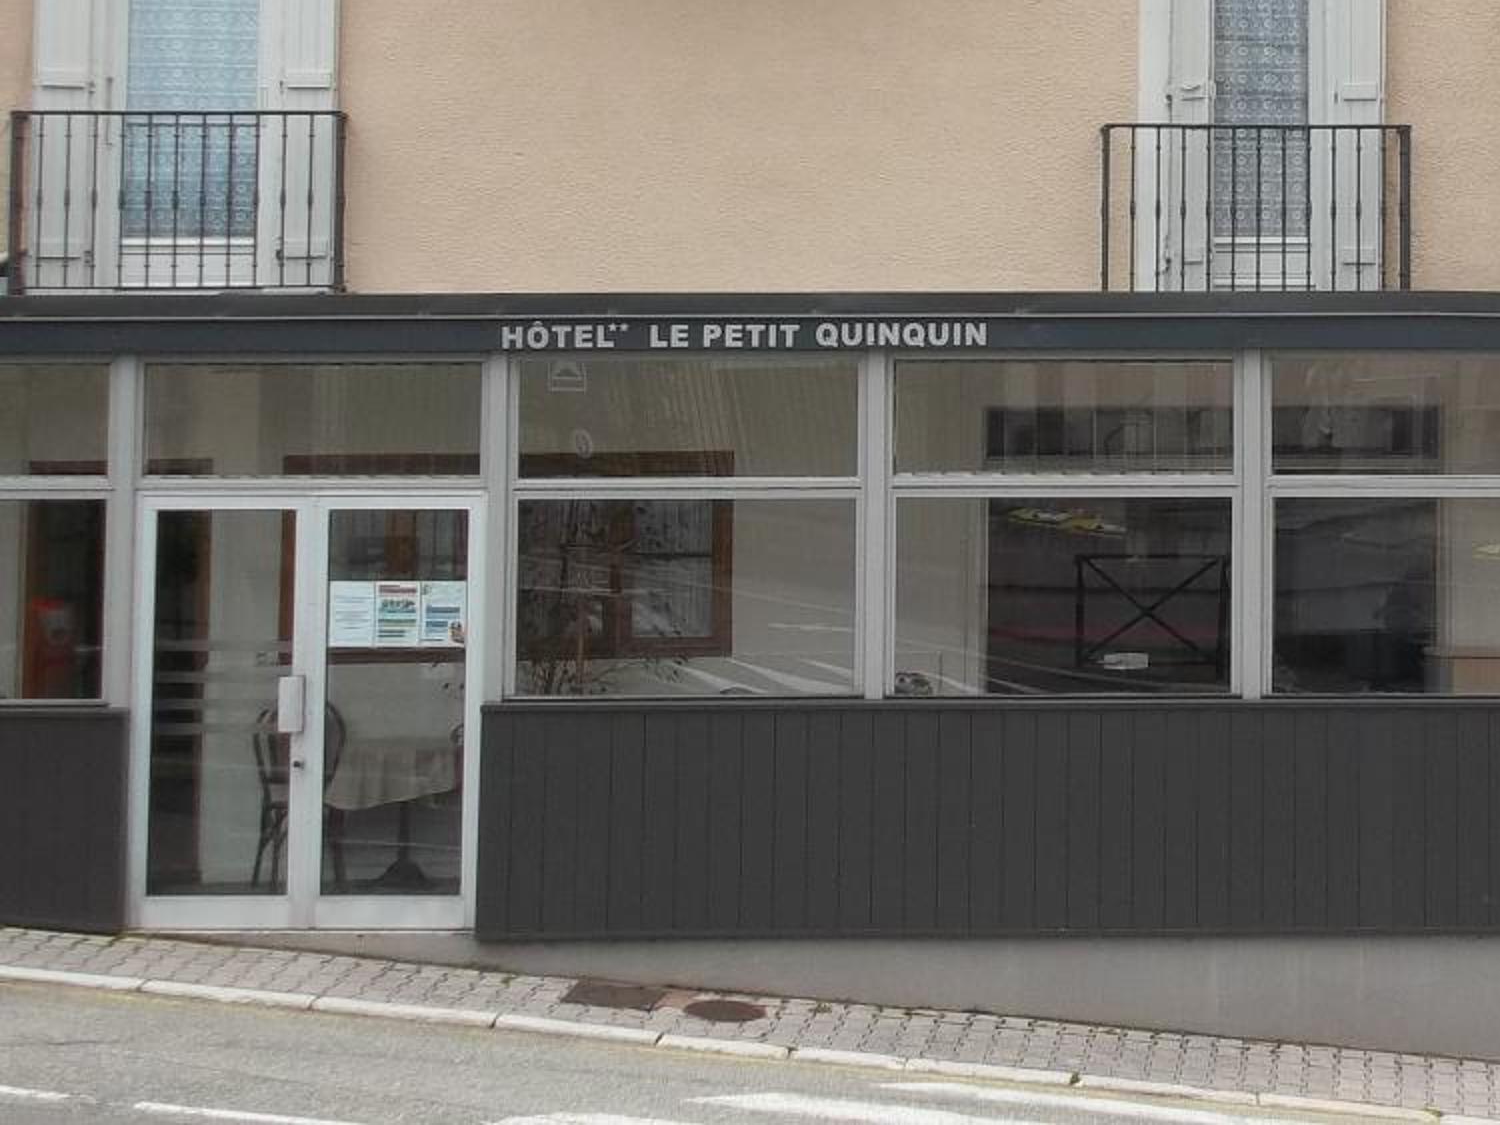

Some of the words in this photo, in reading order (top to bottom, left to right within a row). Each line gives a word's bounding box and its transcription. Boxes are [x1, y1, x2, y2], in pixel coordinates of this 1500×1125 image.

[650, 324, 689, 348] LE
[703, 324, 800, 348] PETIT
[815, 322, 987, 348] QUINQUIN
